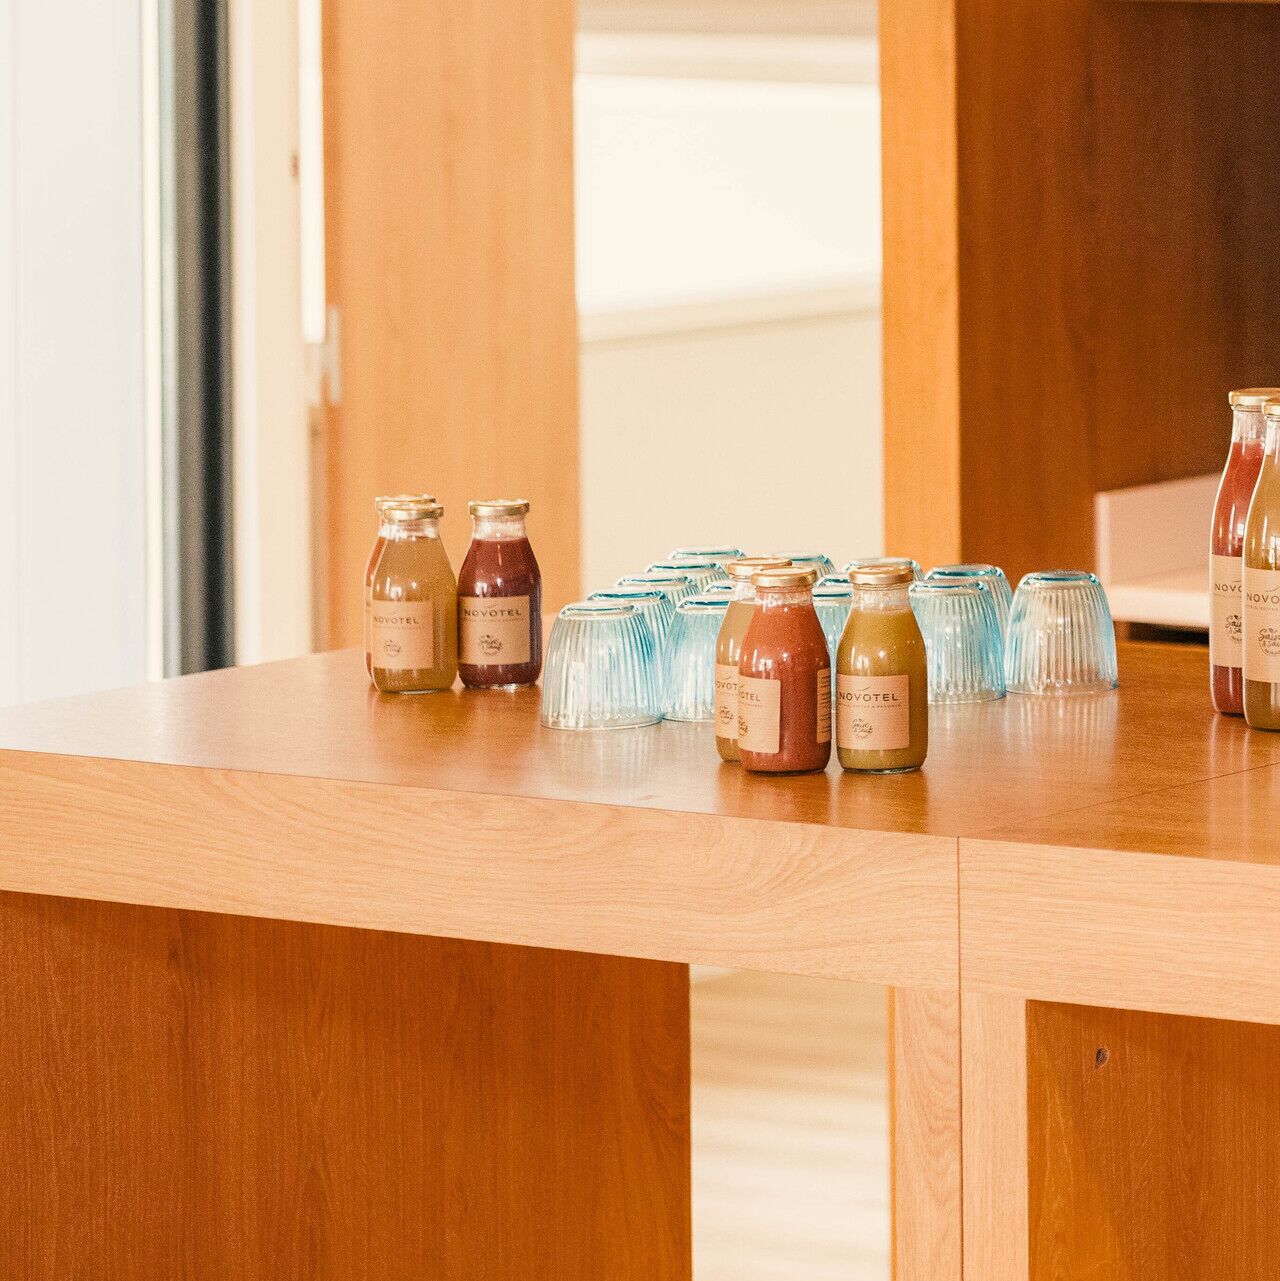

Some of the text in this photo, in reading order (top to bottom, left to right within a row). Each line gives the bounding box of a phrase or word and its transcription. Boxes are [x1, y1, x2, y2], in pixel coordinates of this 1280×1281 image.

[1214, 583, 1242, 593] NOVO
[464, 608, 522, 617] NOVOTEL
[374, 616, 419, 625] NOVOTEL
[839, 692, 899, 702] NOVOTEL
